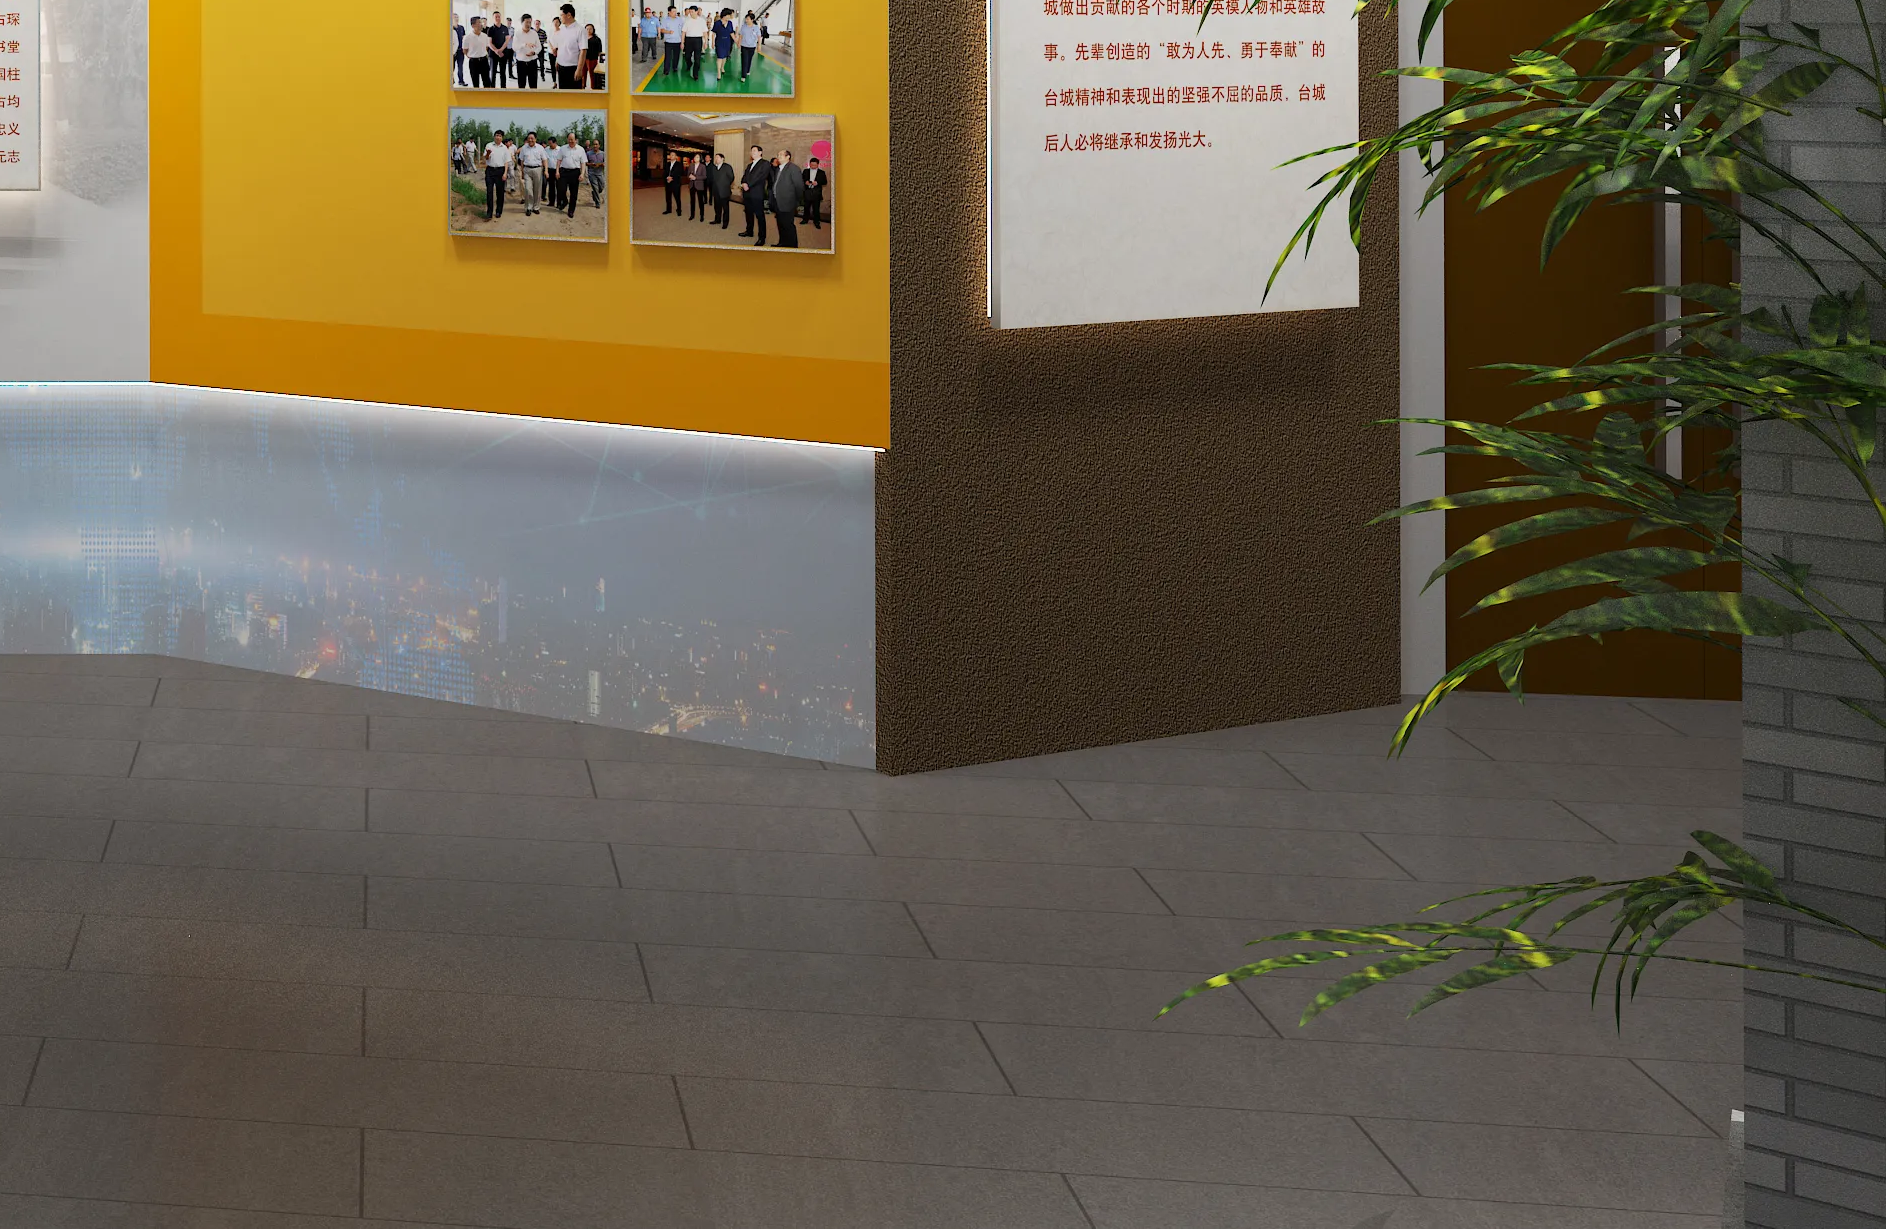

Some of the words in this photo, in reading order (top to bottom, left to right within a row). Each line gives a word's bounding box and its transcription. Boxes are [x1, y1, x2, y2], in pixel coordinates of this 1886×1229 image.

[1043, 40, 1325, 61] 事。先辈创造的“敢为人先、勇于奉献”的
[1043, 83, 1326, 108] 台城精神和表现出的坚强不屈的品质，台城
[1043, 130, 1215, 153] 后人必将继承和发扬光大。
